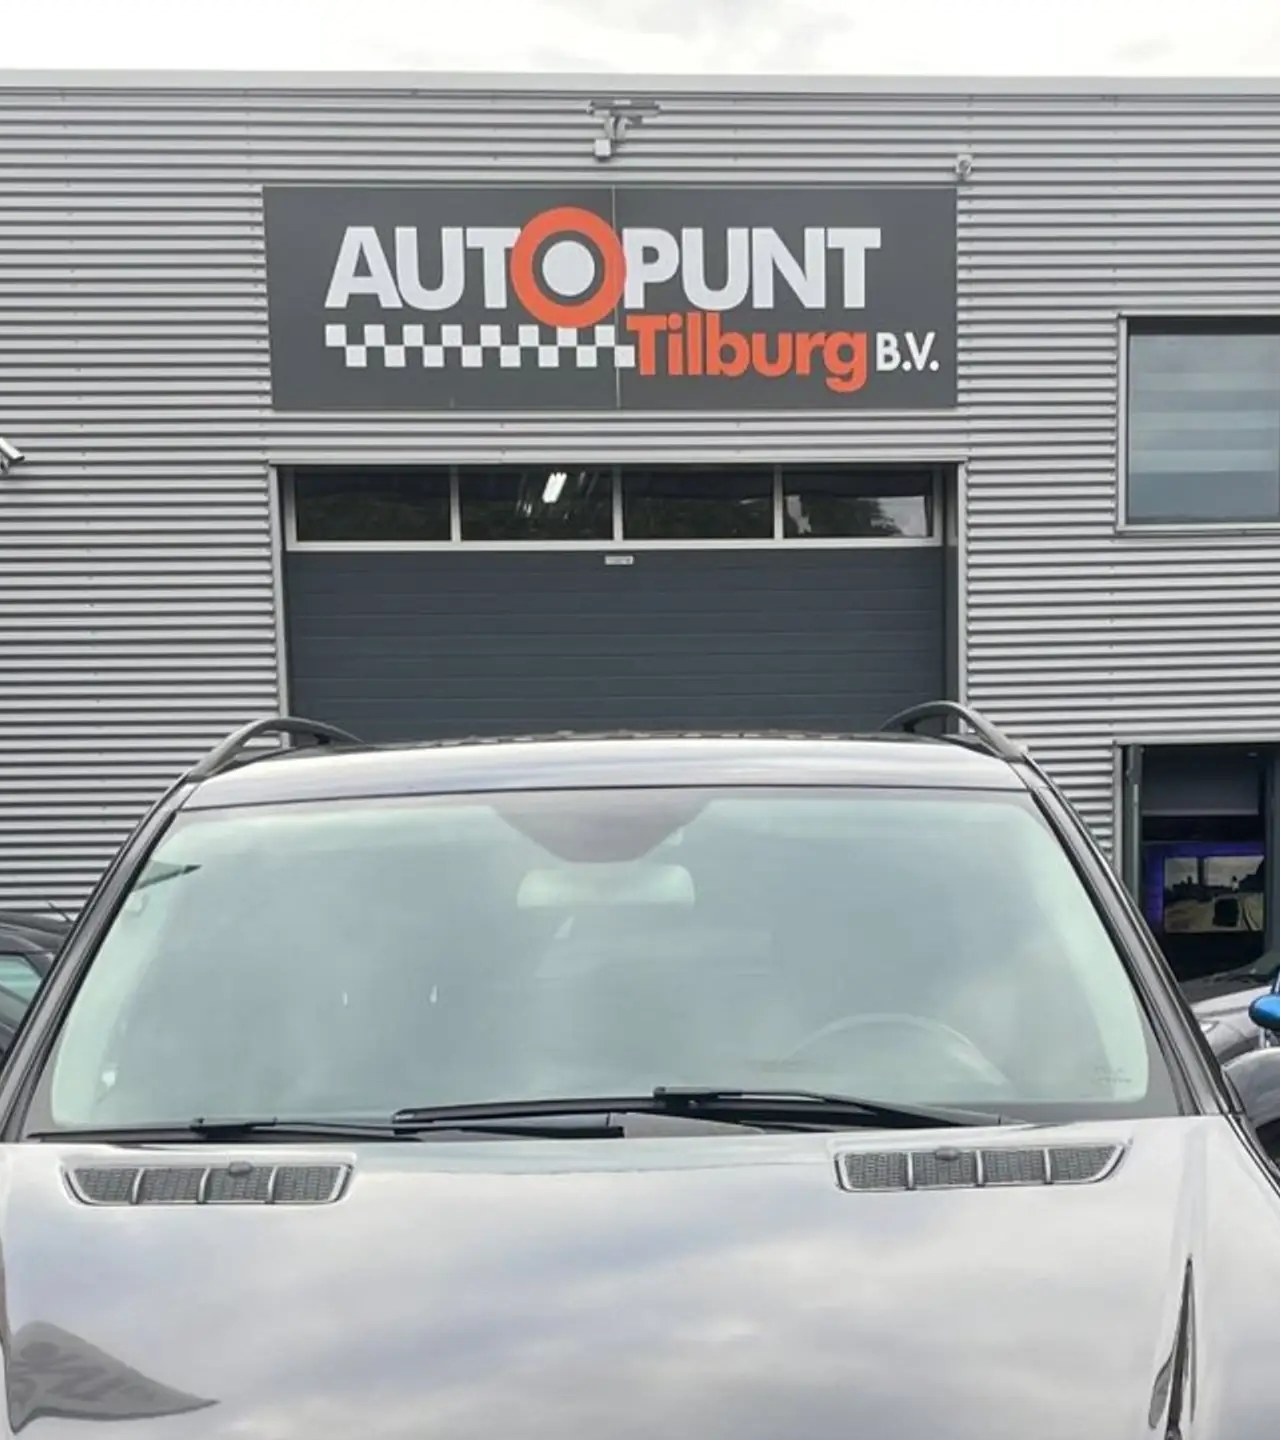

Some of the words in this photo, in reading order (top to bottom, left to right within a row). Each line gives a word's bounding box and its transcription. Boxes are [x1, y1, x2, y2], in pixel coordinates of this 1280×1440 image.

[324, 206, 881, 329] AUTOPUNT
[626, 312, 867, 393] Tilburg
[876, 331, 939, 371] B.V.
